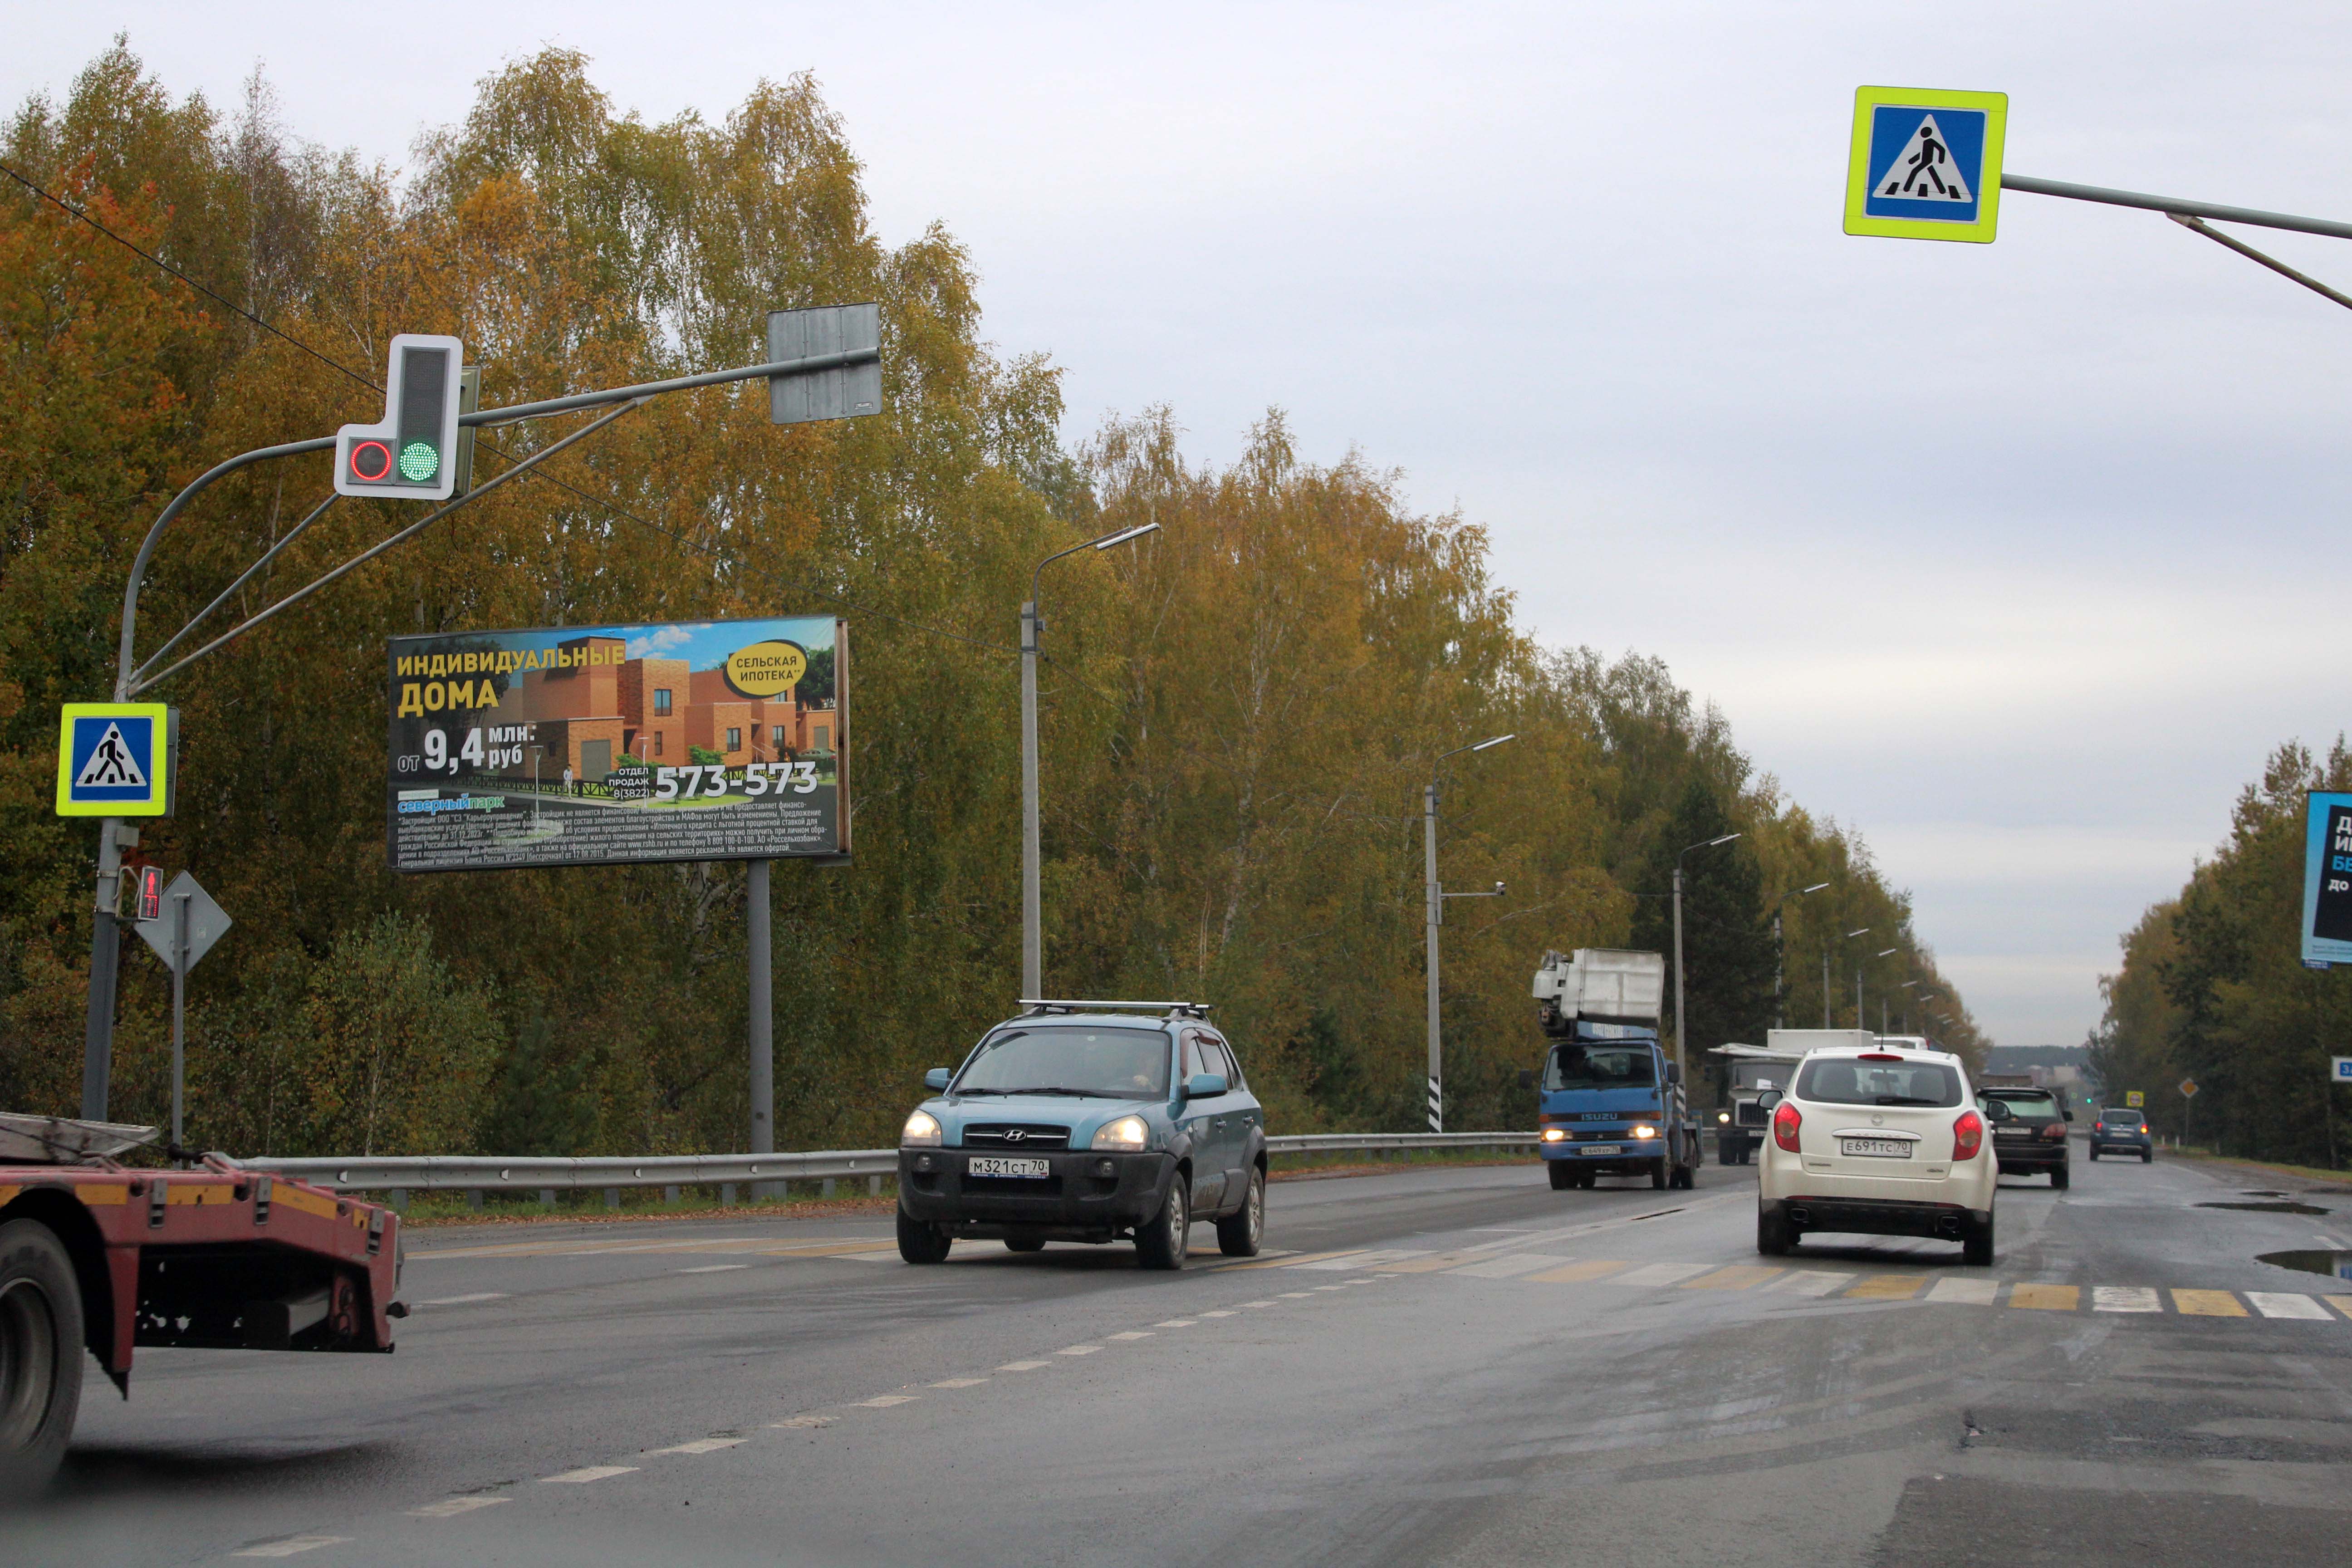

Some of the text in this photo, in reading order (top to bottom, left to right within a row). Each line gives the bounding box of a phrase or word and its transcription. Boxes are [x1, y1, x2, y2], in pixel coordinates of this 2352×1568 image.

[397, 645, 625, 678] ИНДИВИДУАЛЬНЫЕ
[736, 656, 796, 668] СЕЛЬСКАЯ
[398, 679, 499, 718] ДОМА
[397, 755, 419, 771] от
[424, 728, 485, 775] 9,4
[489, 745, 522, 769] руб
[618, 767, 649, 775] ОТДЕЛ
[609, 777, 649, 787] ПРОДАЖ
[655, 761, 817, 798] 573-573
[614, 789, 650, 798] 8(3822)
[688, 822, 711, 830] кредита
[746, 818, 780, 828] процентной
[782, 817, 804, 825] ставкой
[2336, 816, 2352, 835] Д
[746, 828, 773, 837] получить
[774, 828, 785, 836] при
[679, 837, 706, 848] телефону
[712, 837, 723, 845] 800
[2328, 879, 2349, 892] до
[2343, 1064, 2352, 1074] З
[1896, 1142, 1907, 1150] 70
[974, 1160, 1044, 1174] М321СТ 70
